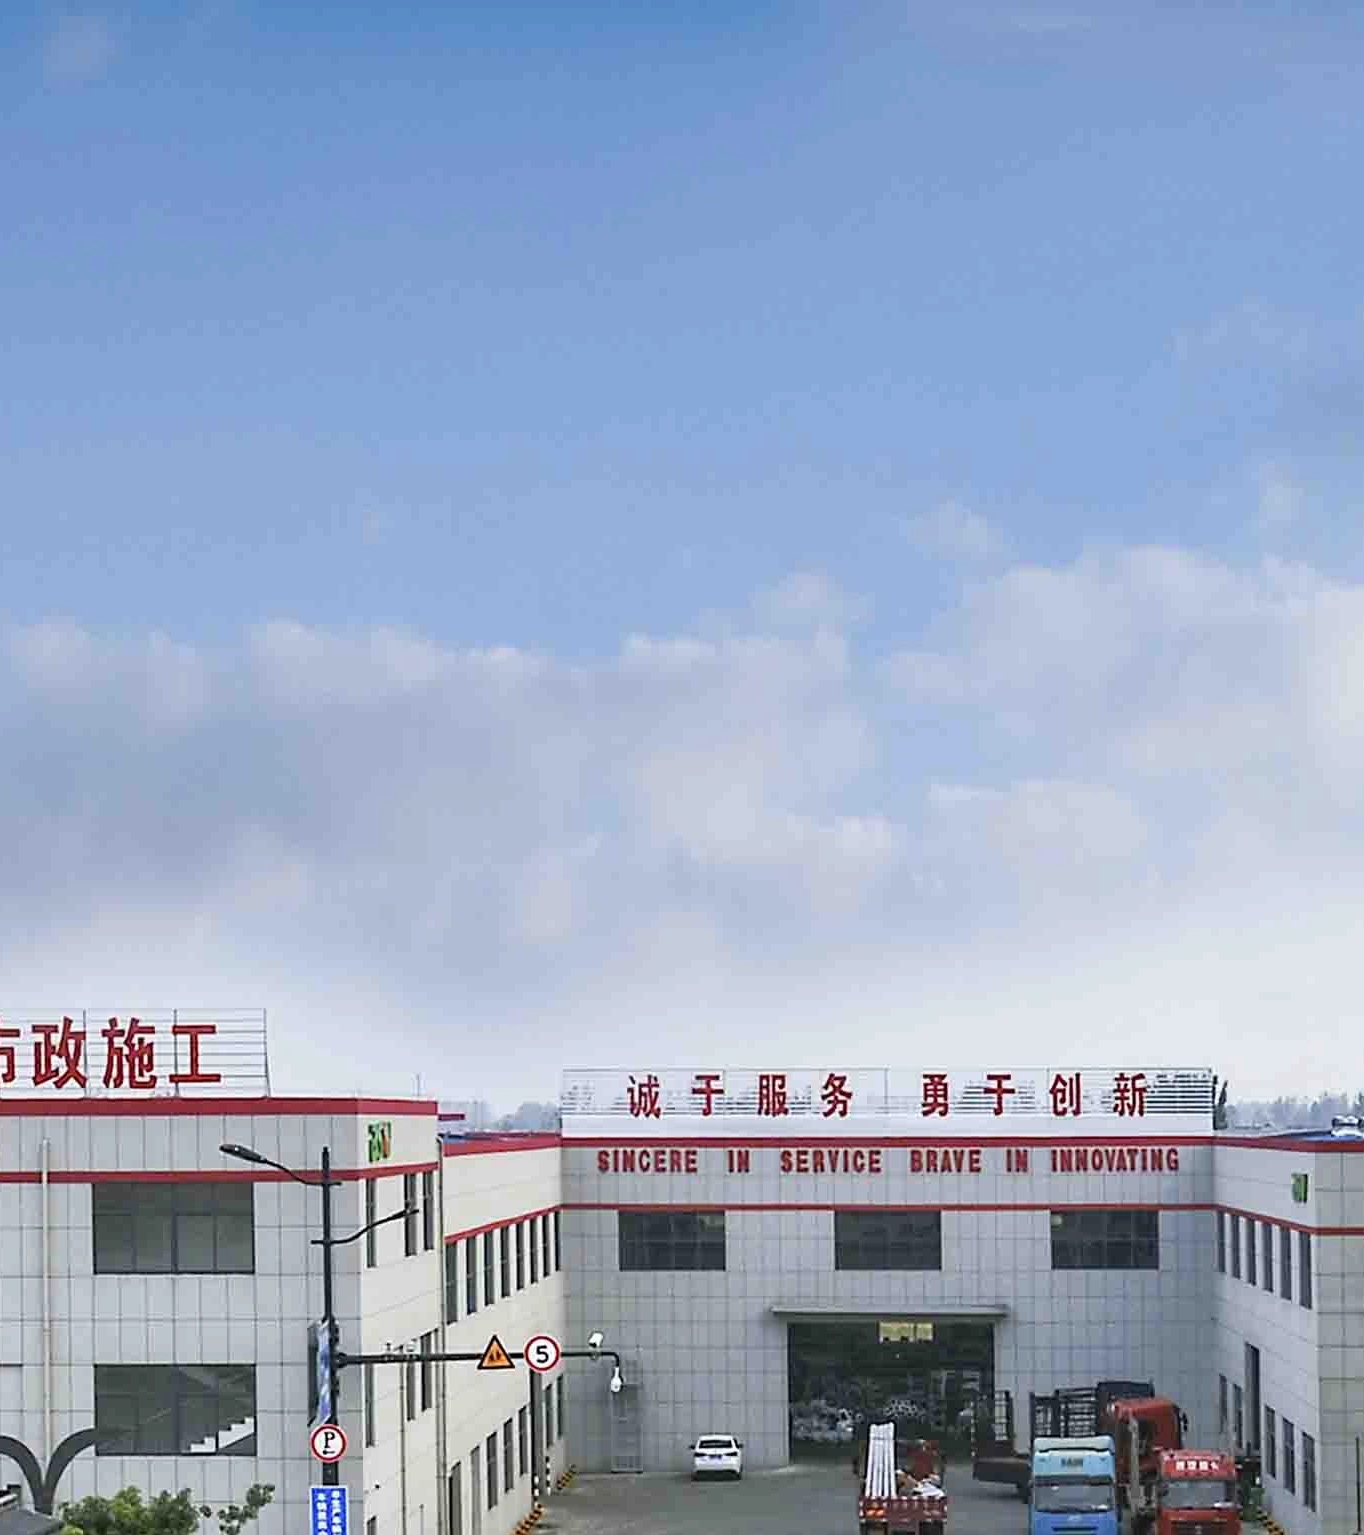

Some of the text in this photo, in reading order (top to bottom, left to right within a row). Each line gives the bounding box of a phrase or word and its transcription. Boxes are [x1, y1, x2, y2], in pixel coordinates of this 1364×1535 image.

[626, 1072, 1149, 1119] 诚于服务 勇于创新
[596, 1149, 1180, 1175] SINCERE IN SERVICE BRAVE IN INNOVATING
[536, 1345, 549, 1364] 5
